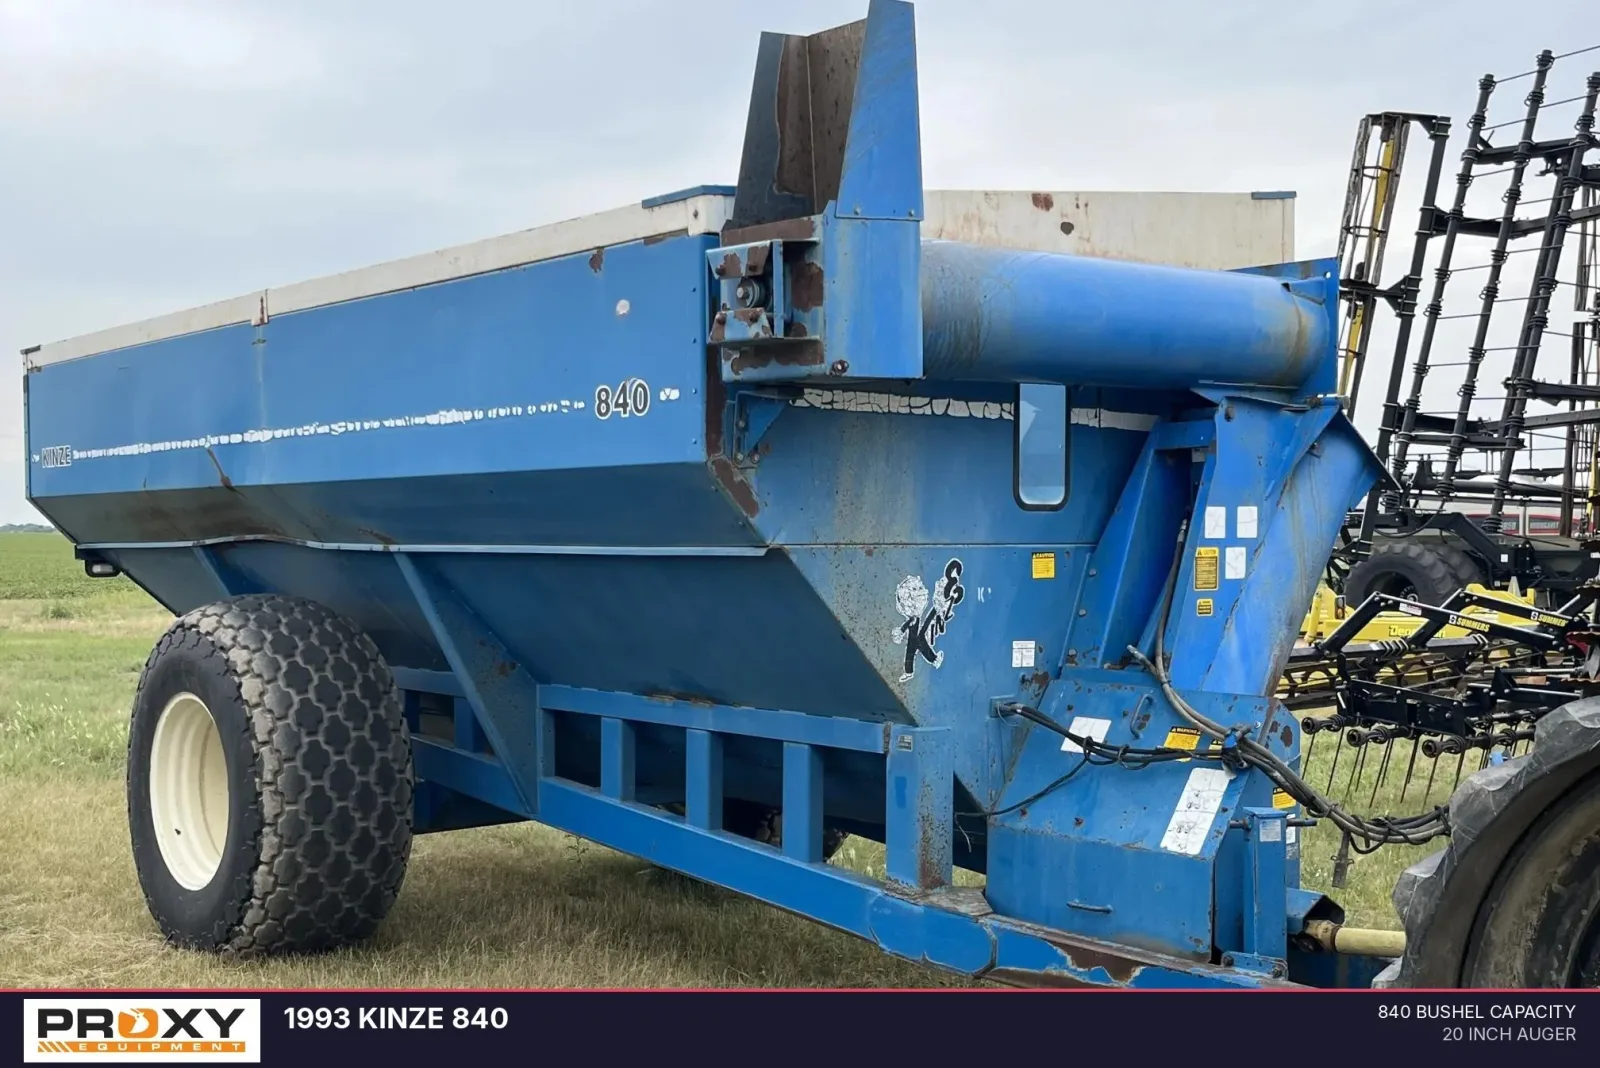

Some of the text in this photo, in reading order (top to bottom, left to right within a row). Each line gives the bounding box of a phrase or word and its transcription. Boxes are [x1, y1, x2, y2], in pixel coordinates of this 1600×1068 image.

[595, 378, 650, 419] 840
[42, 445, 72, 468] KINZE
[1457, 617, 1490, 632] SUMMERS
